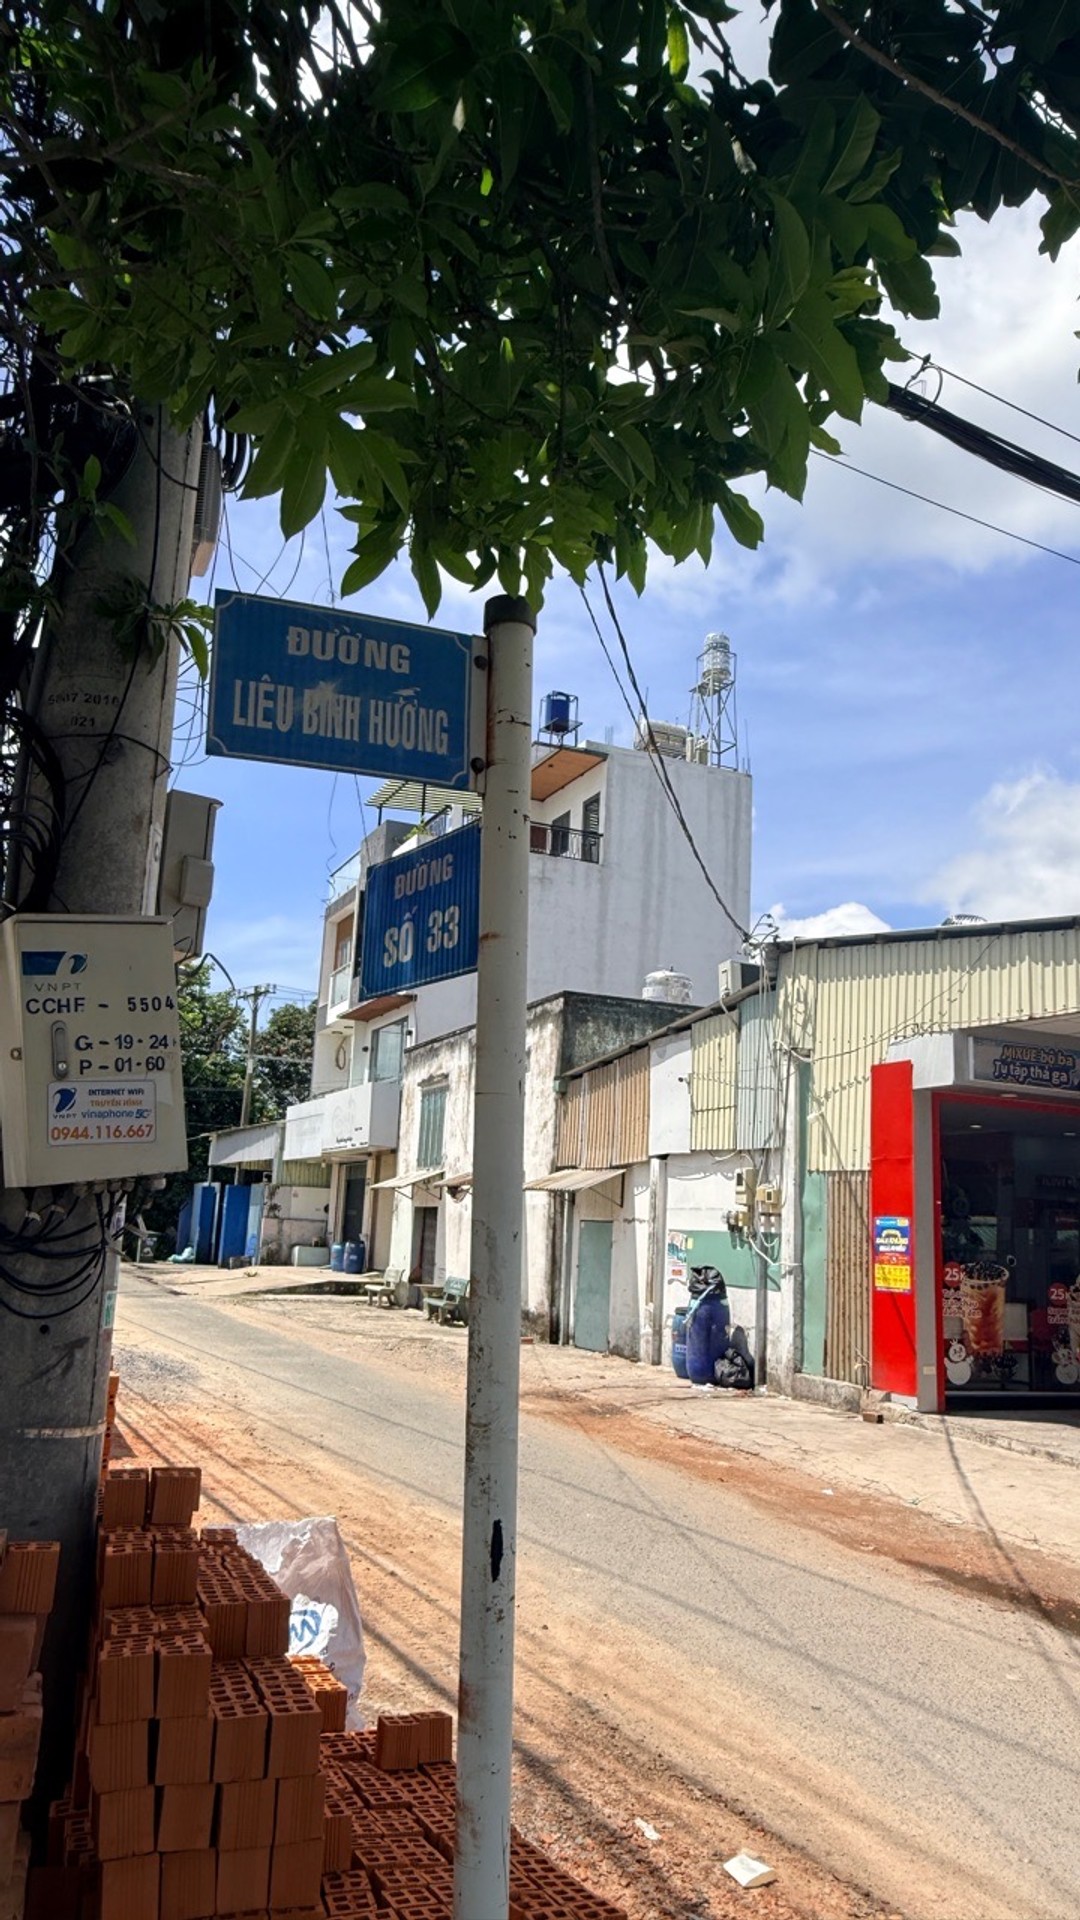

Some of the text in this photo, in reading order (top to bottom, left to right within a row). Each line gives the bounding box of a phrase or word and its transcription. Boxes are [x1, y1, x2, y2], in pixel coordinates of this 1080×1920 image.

[286, 625, 411, 675] ĐƯỜNG
[233, 674, 295, 733] LIÊU
[394, 853, 454, 900] ĐƯỜNG
[383, 905, 460, 969] SỐ 33
[34, 982, 82, 992] VNPT
[26, 997, 86, 1014] CCHF
[127, 996, 175, 1012] 5504
[1002, 1047, 1038, 1061] MIXUE
[1057, 1052, 1073, 1066] ba
[1052, 1071, 1068, 1085] ga
[88, 1088, 126, 1096] INTERNET
[81, 1109, 134, 1120] vinaphone
[51, 1123, 154, 1140] 0944.116.667
